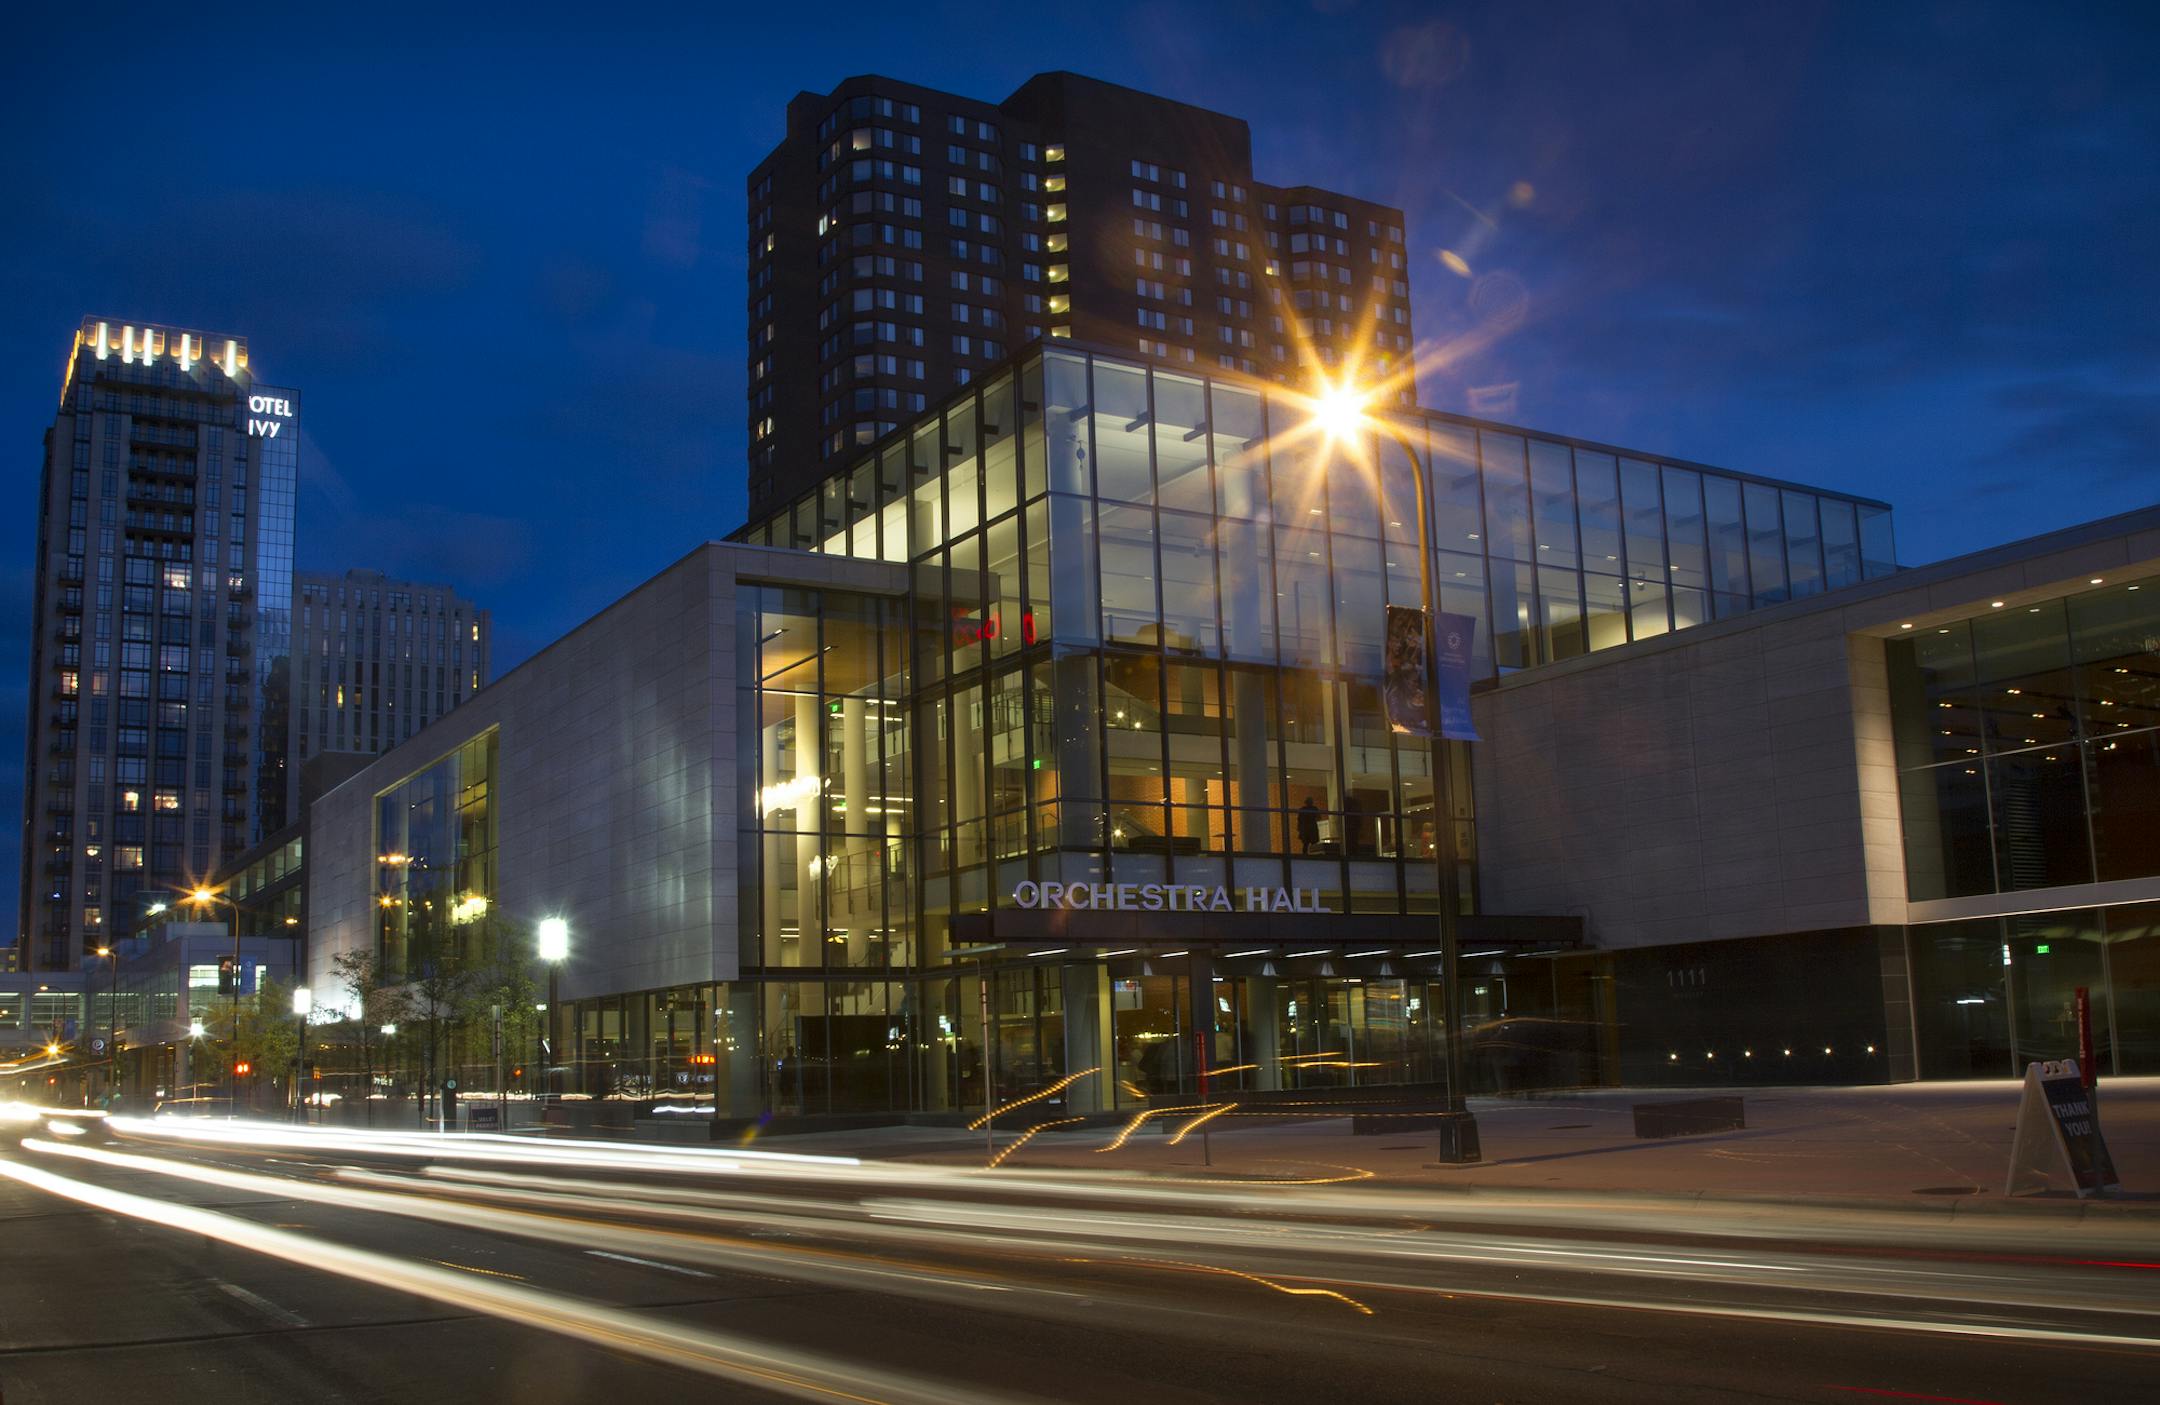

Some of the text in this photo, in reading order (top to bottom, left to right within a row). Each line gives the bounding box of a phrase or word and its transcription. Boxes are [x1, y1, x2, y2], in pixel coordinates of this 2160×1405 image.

[249, 395, 293, 417] OTEL
[248, 419, 281, 438] IVY
[1014, 880, 1331, 912] ORCHESTRA HALL
[1666, 968, 1705, 987] 1111
[2052, 1101, 2090, 1118] THANK
[2065, 1120, 2092, 1137] YOU!
